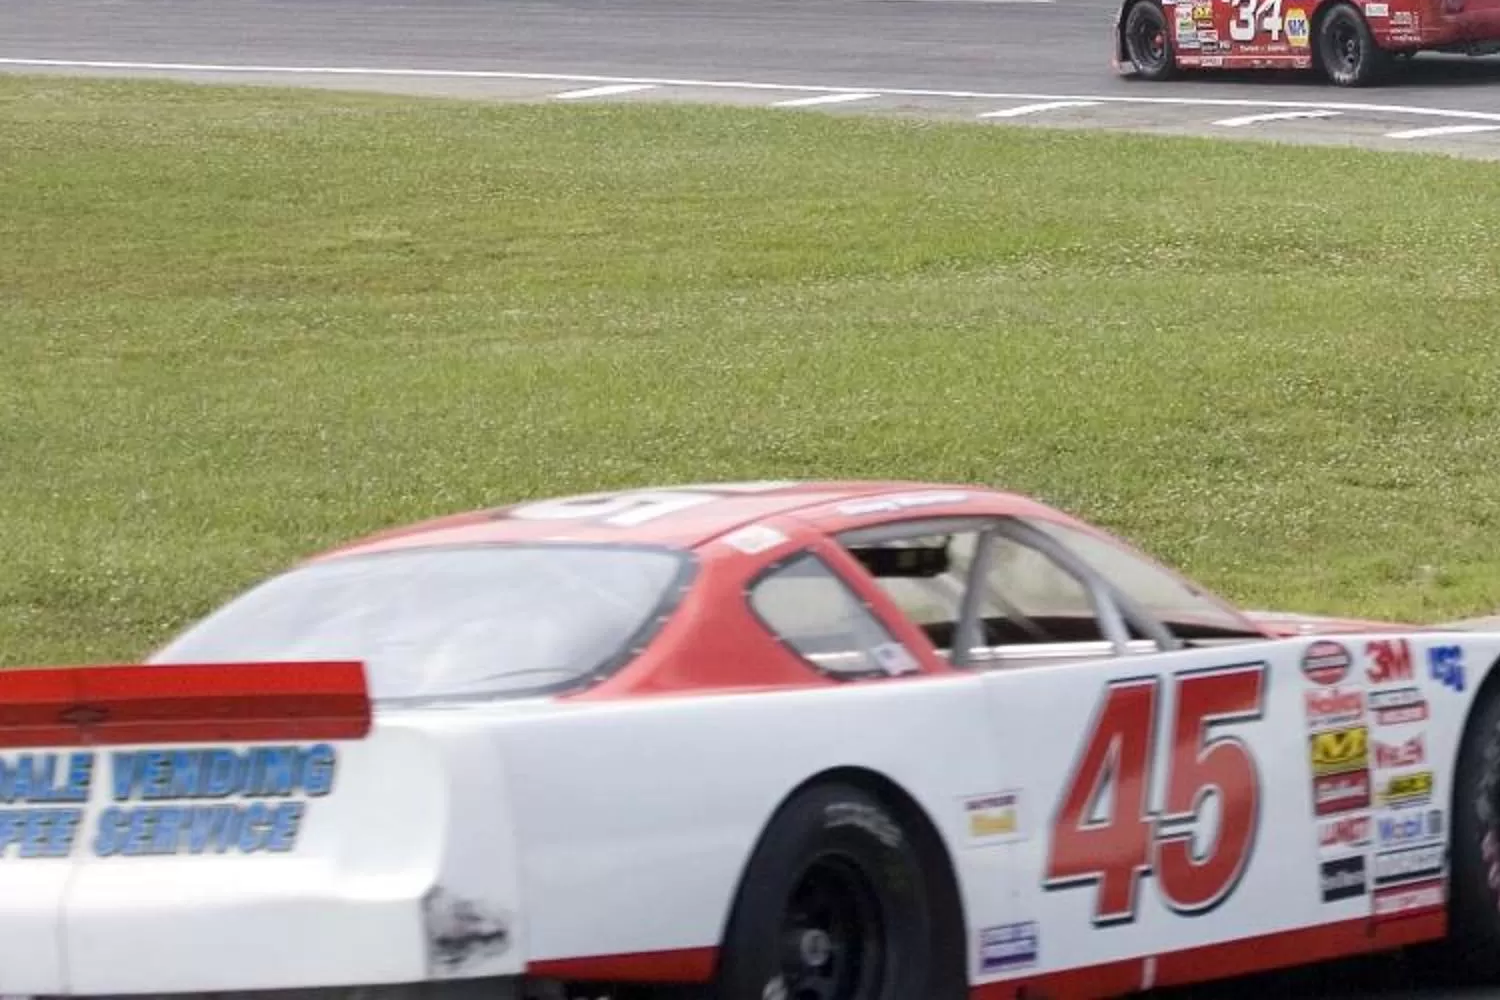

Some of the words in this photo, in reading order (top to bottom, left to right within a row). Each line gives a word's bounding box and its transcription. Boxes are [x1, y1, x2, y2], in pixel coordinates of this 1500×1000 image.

[1365, 639, 1414, 684] 3M
[111, 743, 337, 802] VENDING
[1041, 661, 1269, 928] 45
[94, 801, 306, 858] SERVICE
